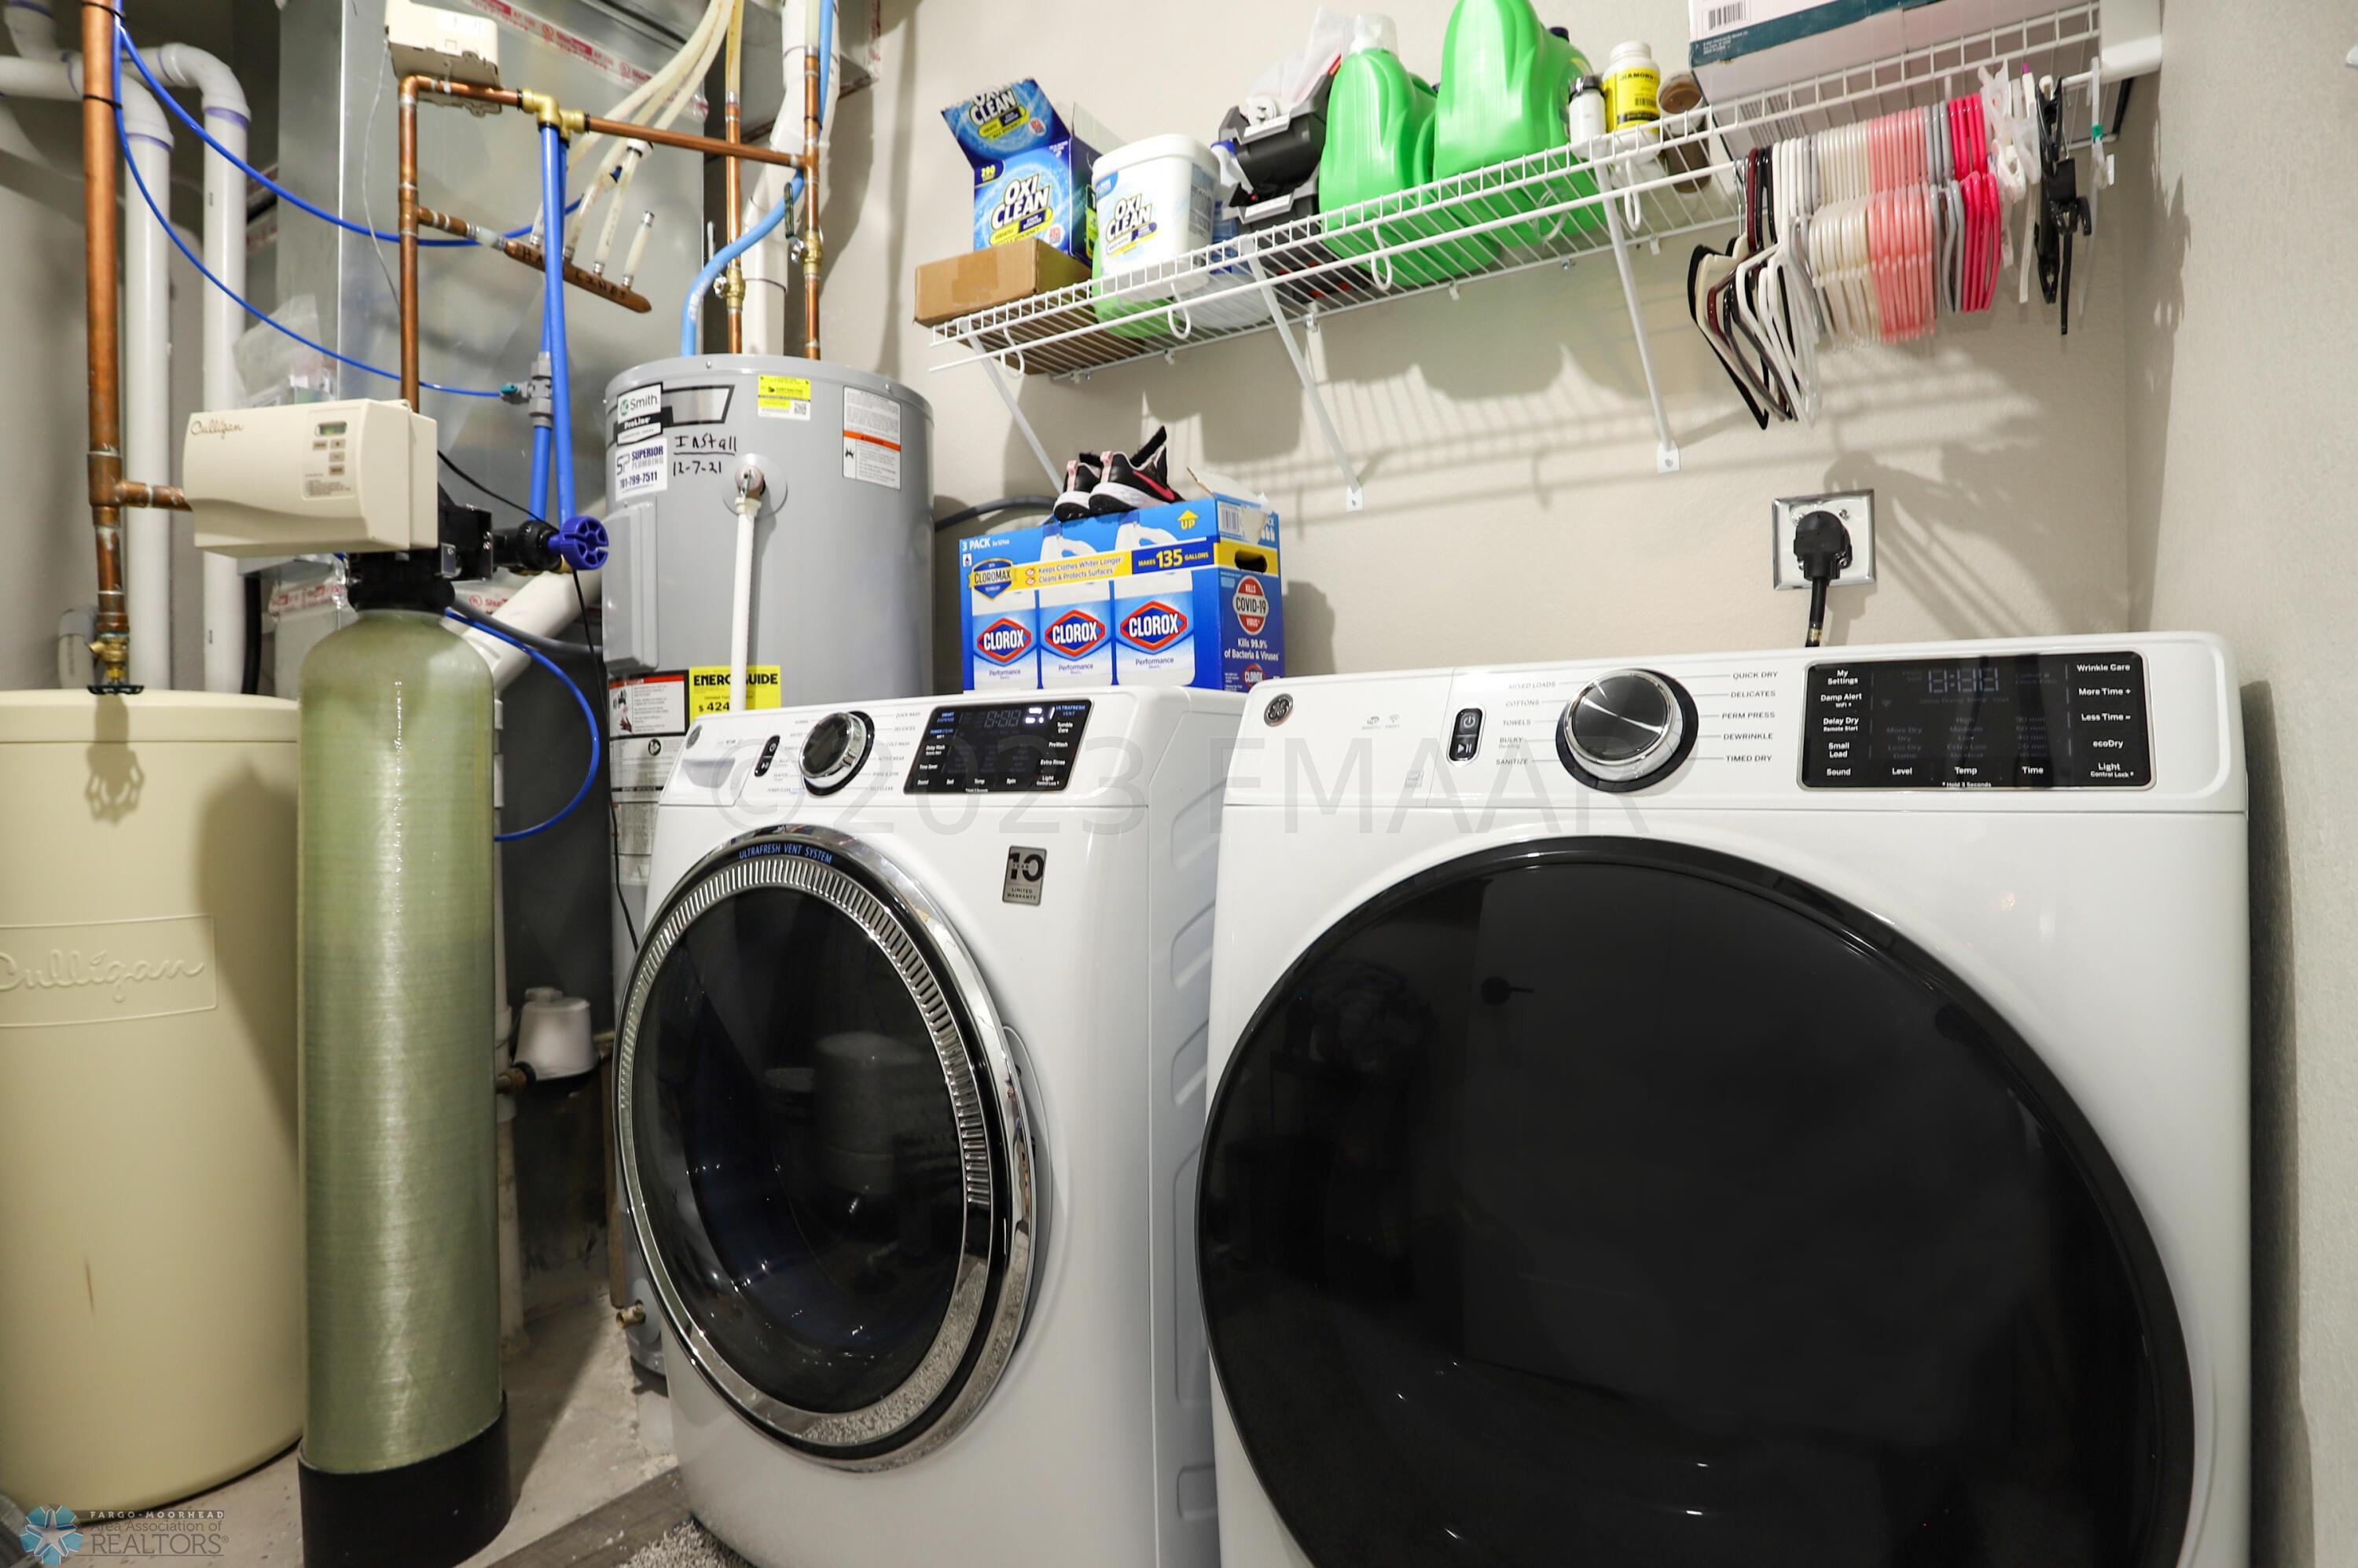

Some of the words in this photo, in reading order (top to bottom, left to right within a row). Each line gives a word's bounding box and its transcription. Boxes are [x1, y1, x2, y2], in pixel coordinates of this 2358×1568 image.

[970, 89, 1017, 126] CLEAN
[1005, 174, 1040, 205] OXI
[991, 185, 1050, 231] CLEAN
[1115, 193, 1142, 221] OXI
[1106, 204, 1151, 243] CLEAN
[630, 395, 658, 410] Smith
[190, 420, 244, 439] Culligan
[632, 446, 663, 461] SUPERIOR
[673, 461, 722, 476] 12-7-21
[1180, 520, 1196, 531] UP
[962, 542, 968, 551] 3
[969, 538, 991, 550] PACK
[1155, 549, 1184, 568] 135
[1185, 552, 1209, 561] GALLONS
[1038, 566, 1056, 575] Keeps
[1056, 563, 1078, 573] Clothes
[1079, 559, 1099, 570] Whiter
[1100, 556, 1122, 568] Longer
[974, 569, 1012, 585] CLOROMAX
[1038, 575, 1057, 584] Cleans
[1063, 571, 1087, 580] Protects
[1088, 567, 1113, 578] Surfaces
[1244, 583, 1256, 594] KILLS
[1236, 596, 1266, 615] COVID-19
[1128, 614, 1180, 637] CLOROX
[1052, 622, 1098, 644] CLOROX
[983, 629, 1025, 651] CLOROX
[1237, 637, 1250, 648] Kills
[1251, 638, 1268, 649] 99.9%
[1135, 656, 1175, 666] Performance
[1224, 649, 1231, 659] of
[1232, 648, 1254, 660] Bacteria
[1255, 652, 1260, 660] &
[1261, 650, 1279, 662] Viruses
[989, 668, 1021, 678] Performance
[1058, 662, 1094, 672] Performance
[2077, 663, 2109, 672] Wrinkle
[2110, 663, 2131, 672] Care
[1244, 670, 1263, 682] CLOROX
[1761, 670, 1779, 679] DRY
[1837, 670, 1849, 678] My
[1844, 692, 1862, 701] Alert
[2078, 688, 2100, 696] More
[2101, 687, 2124, 696] Time
[706, 701, 730, 711] 424
[1824, 718, 1844, 726] Delay
[1846, 717, 1860, 725] Dry
[2081, 713, 2101, 722] Less
[2102, 713, 2124, 722] Time
[2092, 740, 2124, 749] ecoDry
[1827, 768, 1851, 777] Sound
[1892, 767, 1912, 776] Level
[1954, 766, 1978, 776] Temp
[2022, 766, 2044, 774] Time
[2098, 762, 2121, 772] Light
[739, 843, 781, 860] ULTRAFRESH
[784, 844, 803, 855] VENT
[804, 846, 833, 864] SYSTEM
[1008, 852, 1045, 882] 10
